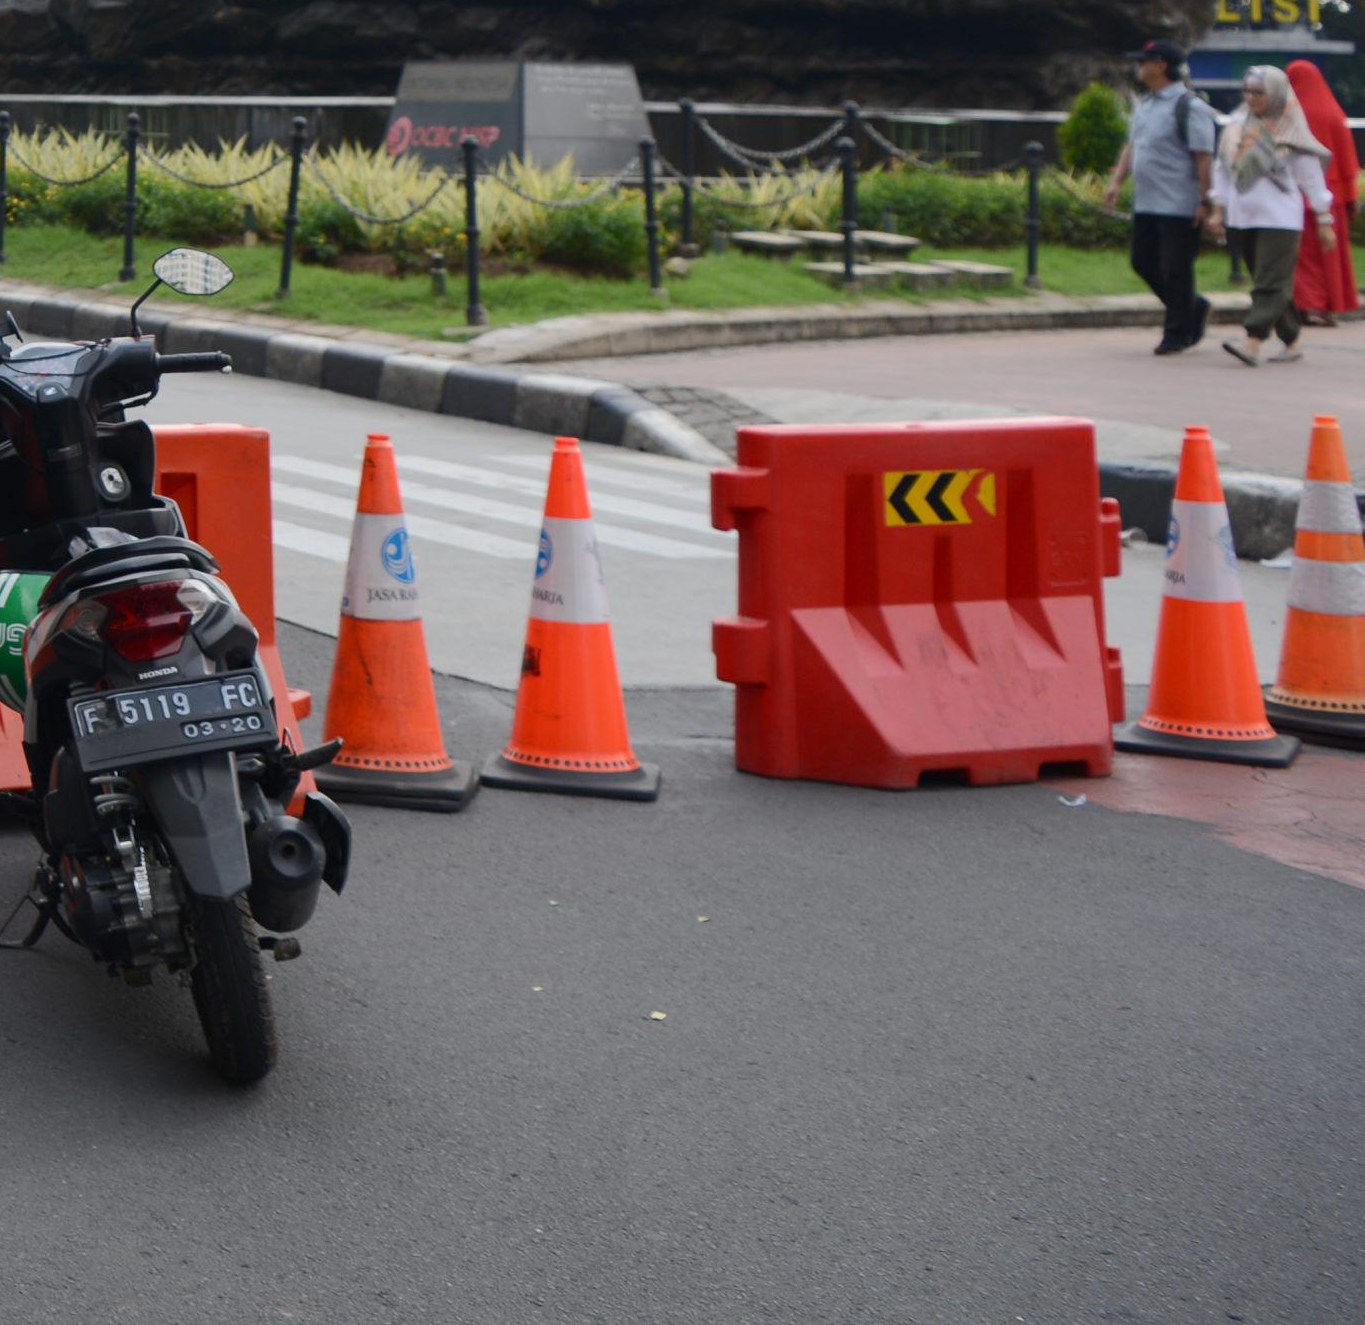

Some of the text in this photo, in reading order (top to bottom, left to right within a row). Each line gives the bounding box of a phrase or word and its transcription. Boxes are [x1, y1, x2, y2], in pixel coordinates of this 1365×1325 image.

[138, 666, 178, 680] HONDA
[119, 692, 191, 725] 5119
[221, 683, 257, 710] FC
